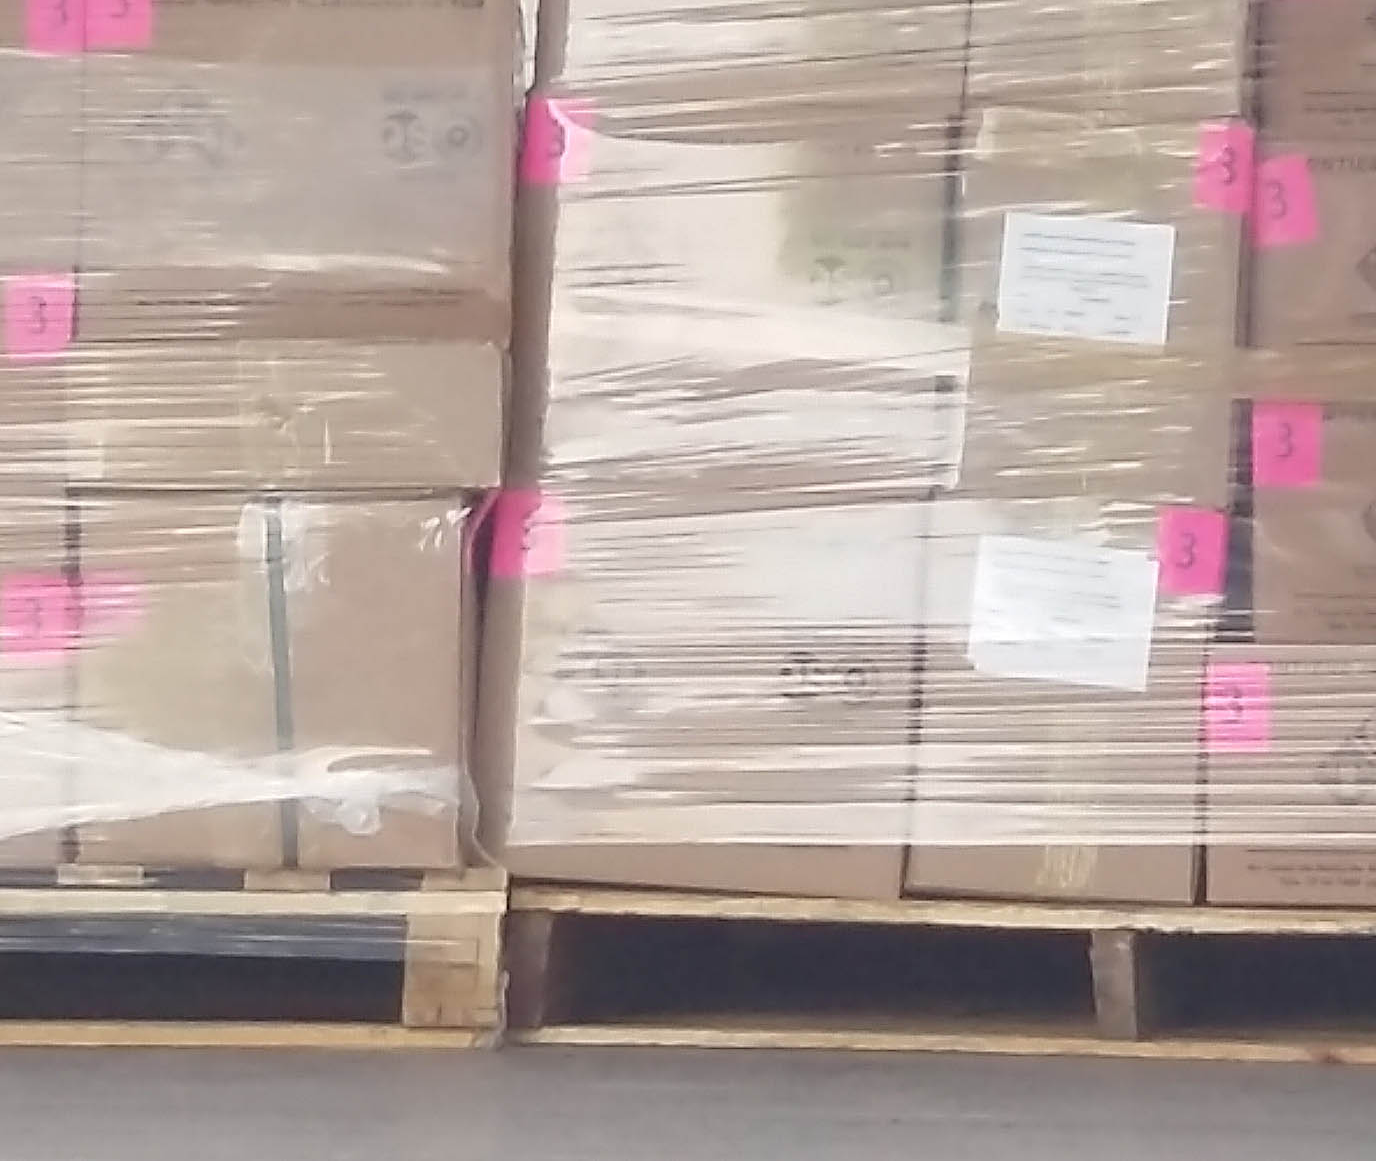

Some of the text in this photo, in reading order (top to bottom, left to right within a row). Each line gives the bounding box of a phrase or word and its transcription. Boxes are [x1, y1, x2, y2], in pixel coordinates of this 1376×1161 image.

[1217, 142, 1236, 187] 3
[1266, 180, 1288, 221] 3
[30, 295, 47, 336] 3
[1272, 421, 1295, 459] 3
[1174, 531, 1197, 571] 3
